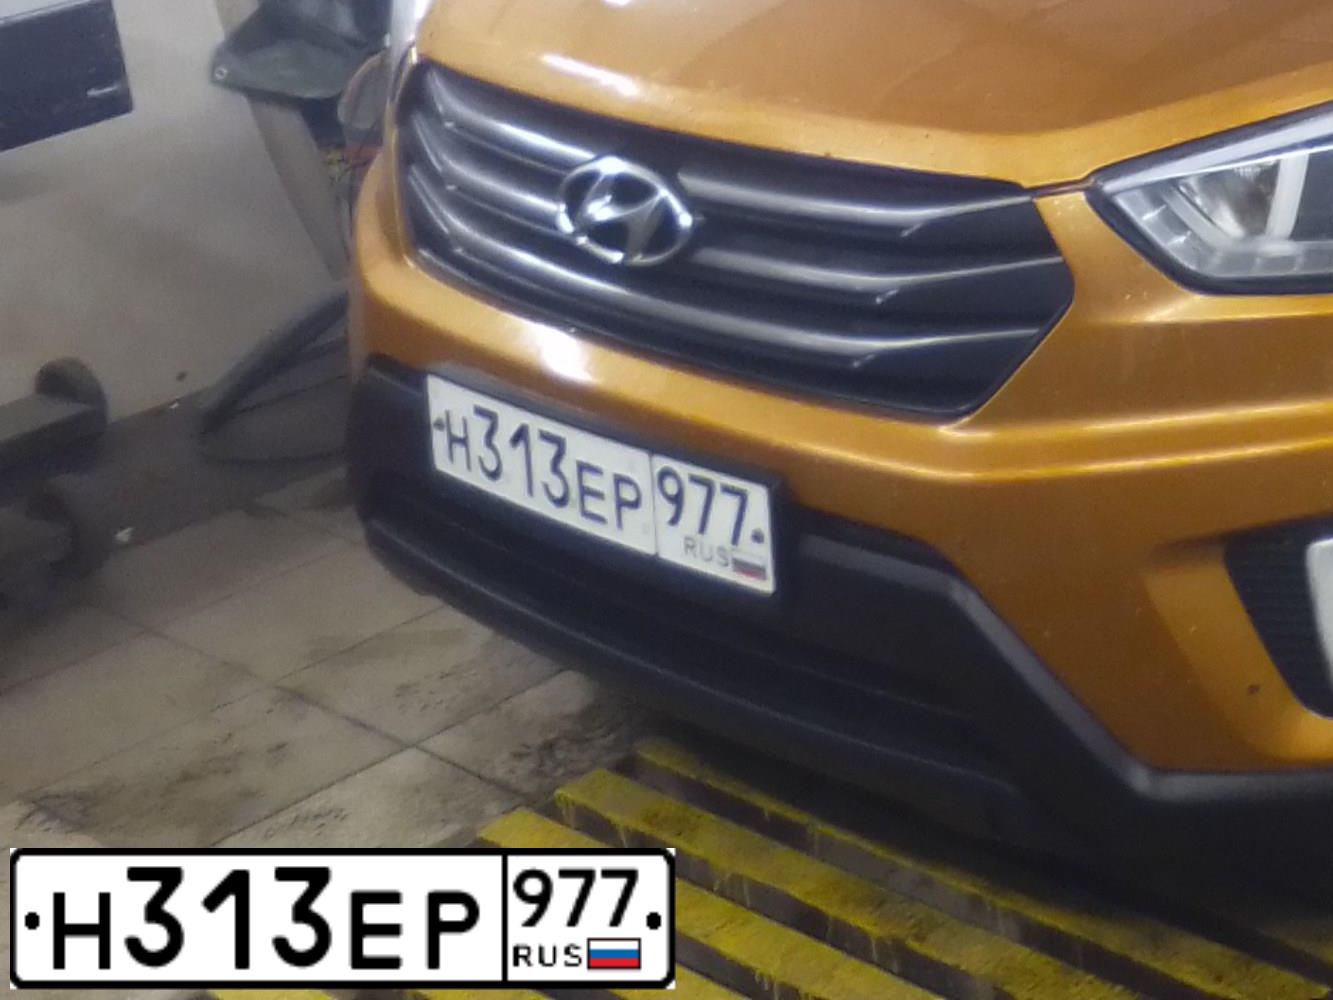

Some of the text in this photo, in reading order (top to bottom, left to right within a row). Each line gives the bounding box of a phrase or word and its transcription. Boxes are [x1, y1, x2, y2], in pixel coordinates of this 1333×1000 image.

[444, 404, 749, 547] Н313ЕР 977
[683, 536, 731, 568] RUS
